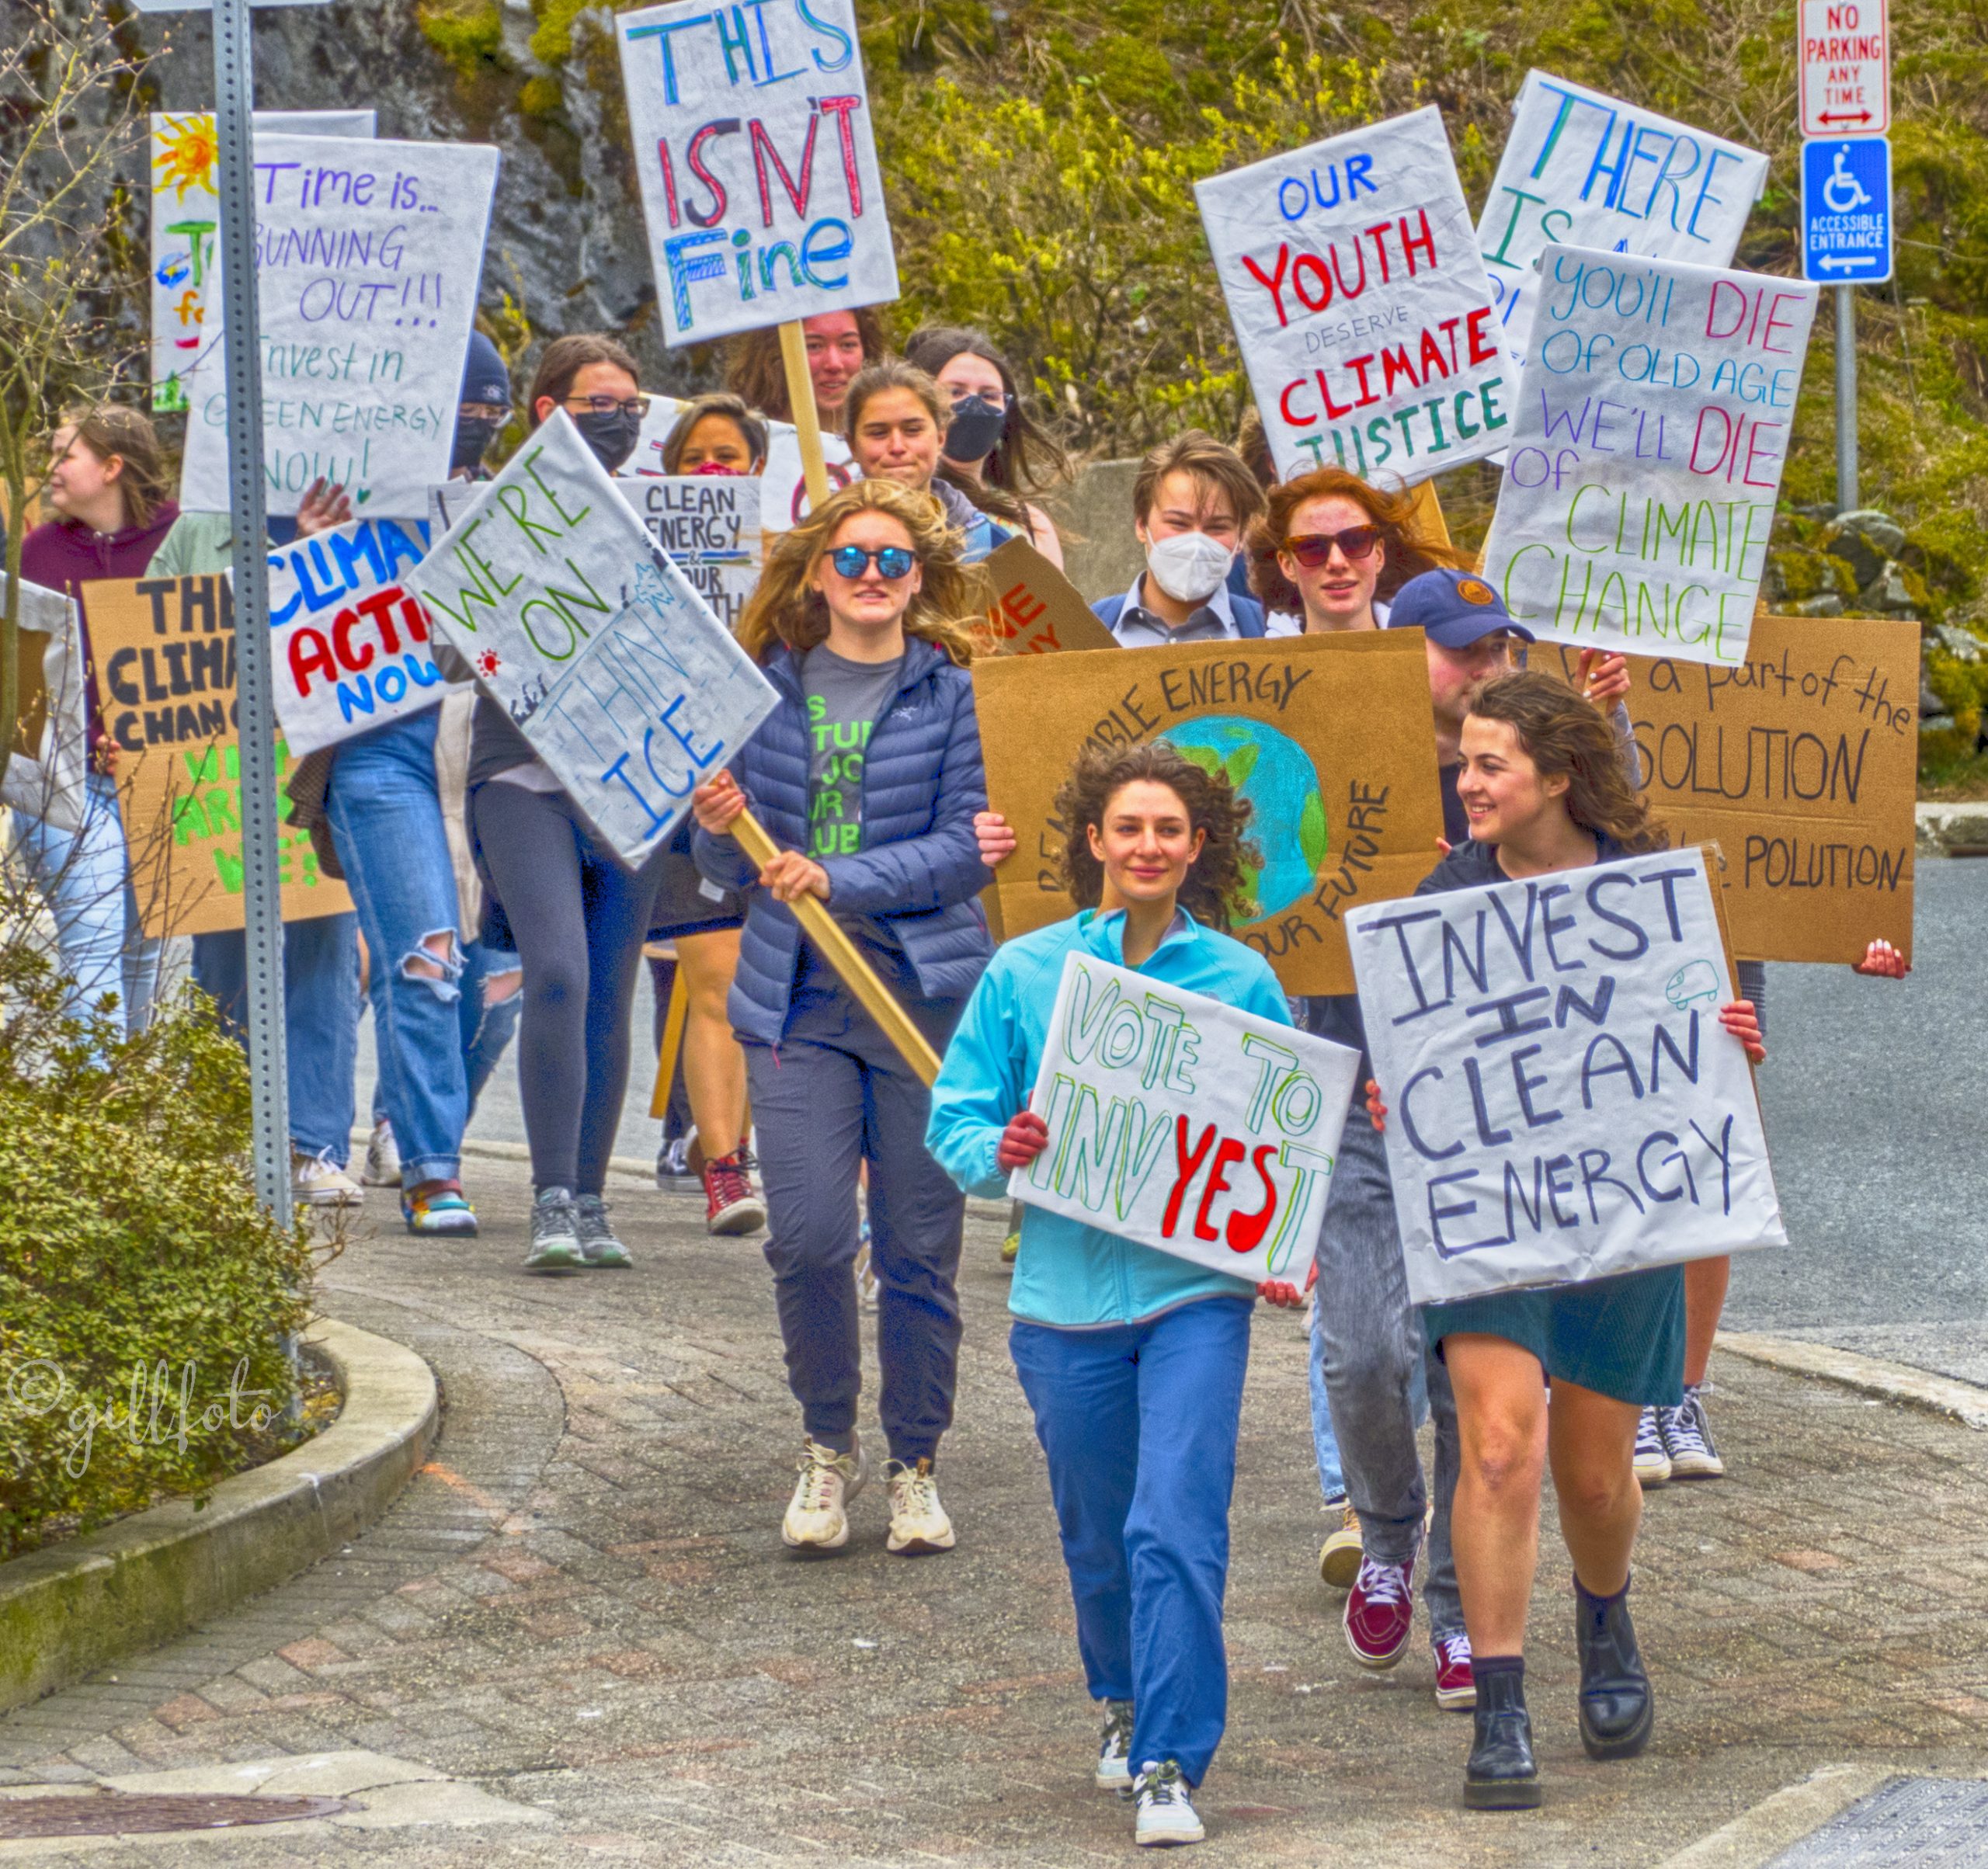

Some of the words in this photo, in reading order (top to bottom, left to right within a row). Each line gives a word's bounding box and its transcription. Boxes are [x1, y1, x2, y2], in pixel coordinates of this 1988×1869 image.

[626, 0, 853, 106] THIS
[1806, 36, 1881, 63] PARKING
[1827, 5, 1859, 31] NO
[1825, 86, 1865, 106] TIME
[1828, 66, 1862, 84] ANY
[253, 162, 376, 210] Time
[658, 95, 862, 228] ISN'T
[1278, 153, 1380, 222] OUR
[1531, 81, 1743, 244] THERE
[1810, 213, 1885, 233] ACCESSIBLE
[1810, 231, 1884, 252] ENTRANCE
[663, 217, 853, 332] Fine
[1242, 207, 1437, 327] YOUTH
[1305, 305, 1409, 354] DESERVE
[1705, 280, 1807, 354] DIE
[368, 349, 405, 383] in
[1280, 307, 1499, 426] CLIMATE
[1618, 344, 1701, 389] OLD
[1711, 358, 1797, 408] AGE
[332, 404, 445, 441] ENERGY
[1541, 388, 1673, 460] WE'LL
[1688, 405, 1784, 488] DIE
[422, 445, 591, 633] WE'RE
[644, 515, 741, 550] ENERGY
[645, 484, 735, 515] CLEAN
[1566, 483, 1774, 583] CLIMATE
[520, 557, 611, 662] ON
[1503, 544, 1751, 661] CHANGE
[543, 609, 690, 763] THIN
[1159, 660, 1314, 713] ENERGY
[1649, 658, 1682, 693] a
[1854, 665, 1911, 736] the
[600, 693, 725, 842] ICE
[1632, 720, 1871, 804] SOLUTION
[1314, 780, 1390, 922] FUTURE
[1745, 834, 1906, 893] POLUTION
[1357, 867, 1697, 1026] INVEST
[1062, 962, 1202, 1096] VOTE
[1242, 1031, 1322, 1137] TO
[1465, 974, 1616, 1049] IN
[1399, 1009, 1699, 1162] CLEAN
[1427, 1113, 1734, 1259] ENERGY
